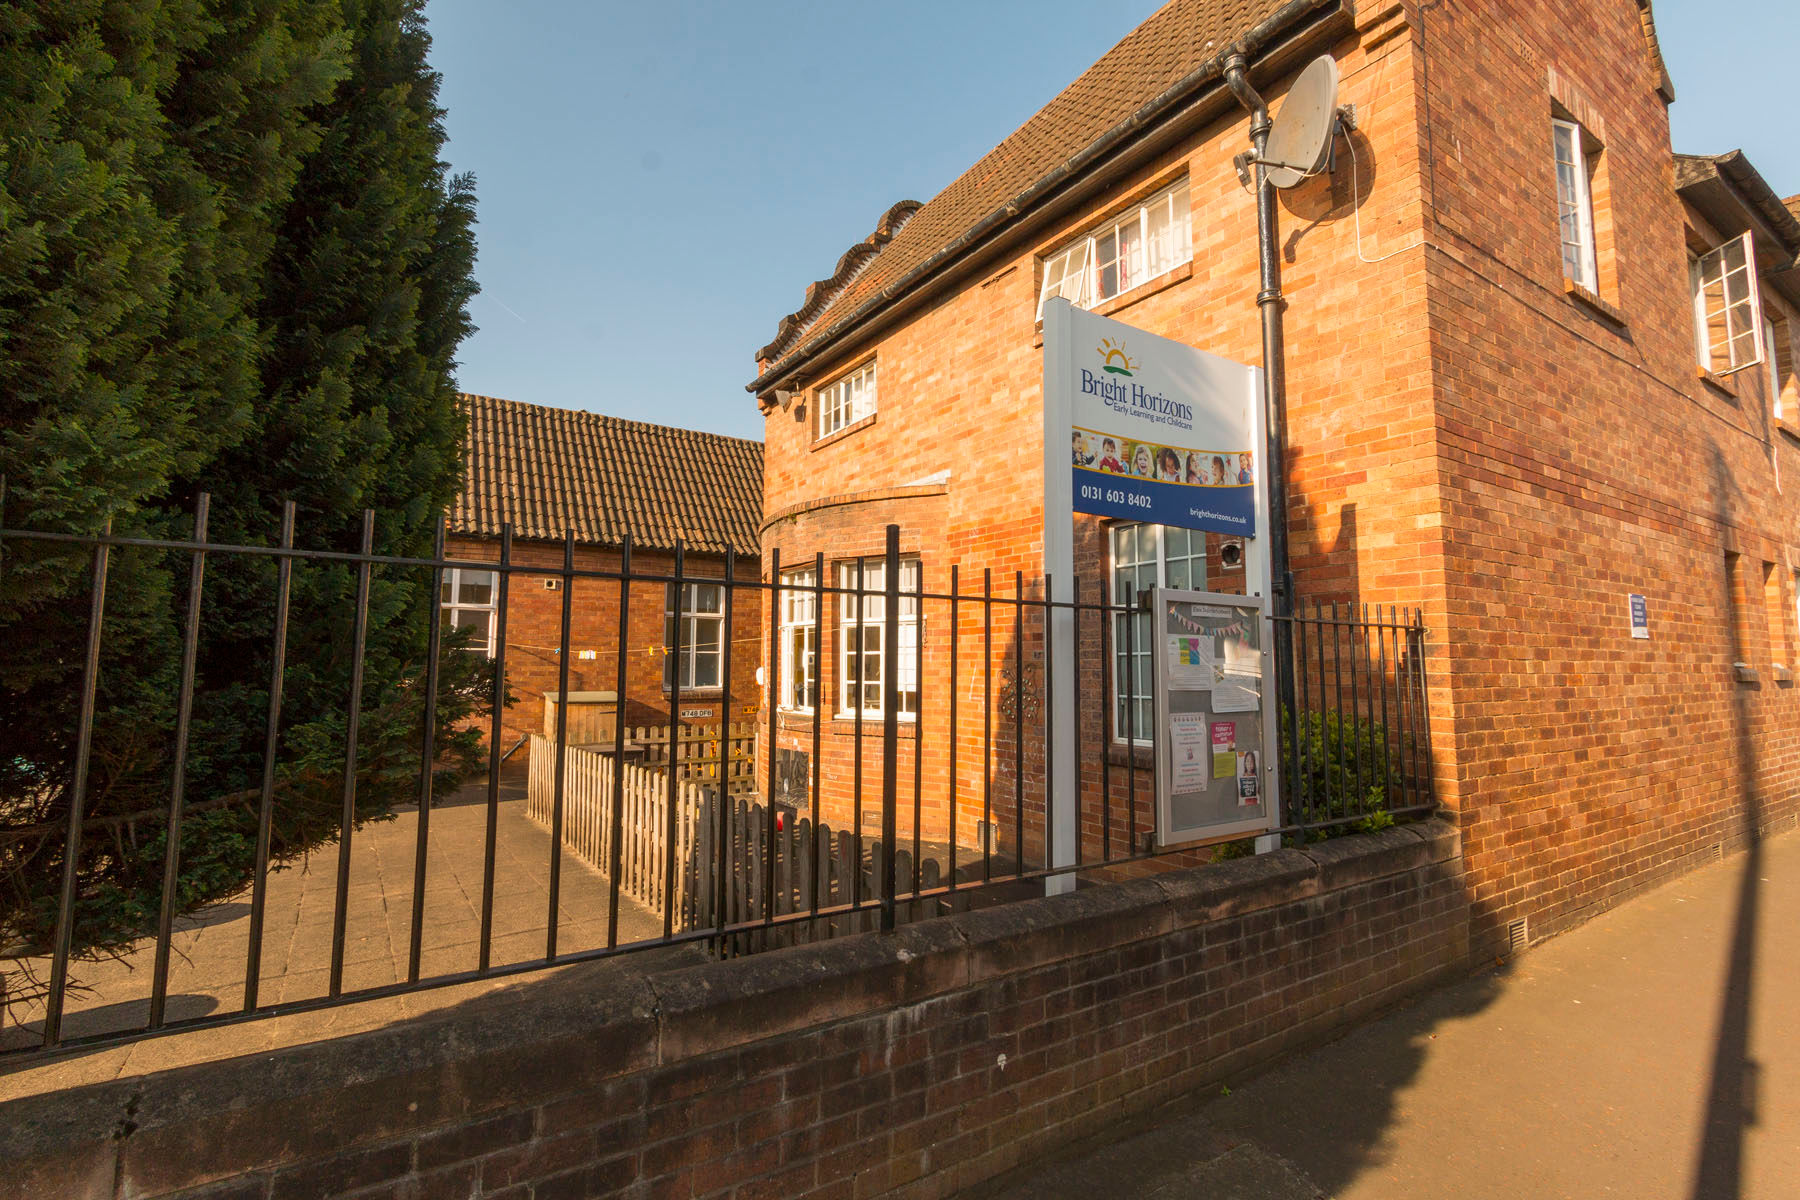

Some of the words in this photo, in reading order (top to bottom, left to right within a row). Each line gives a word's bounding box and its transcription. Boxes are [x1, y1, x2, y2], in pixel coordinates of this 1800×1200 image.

[1081, 368, 1127, 406] Bright
[1131, 382, 1193, 421] Horizons
[1113, 402, 1130, 416] Early
[1130, 407, 1155, 423] Learning
[1155, 415, 1166, 424] and
[1166, 416, 1193, 431] Childcare
[1081, 485, 1102, 500] 0131
[1106, 489, 1125, 504] 603
[1127, 493, 1152, 509] 8402
[1189, 507, 1247, 525] brighthorizons.co.uk
